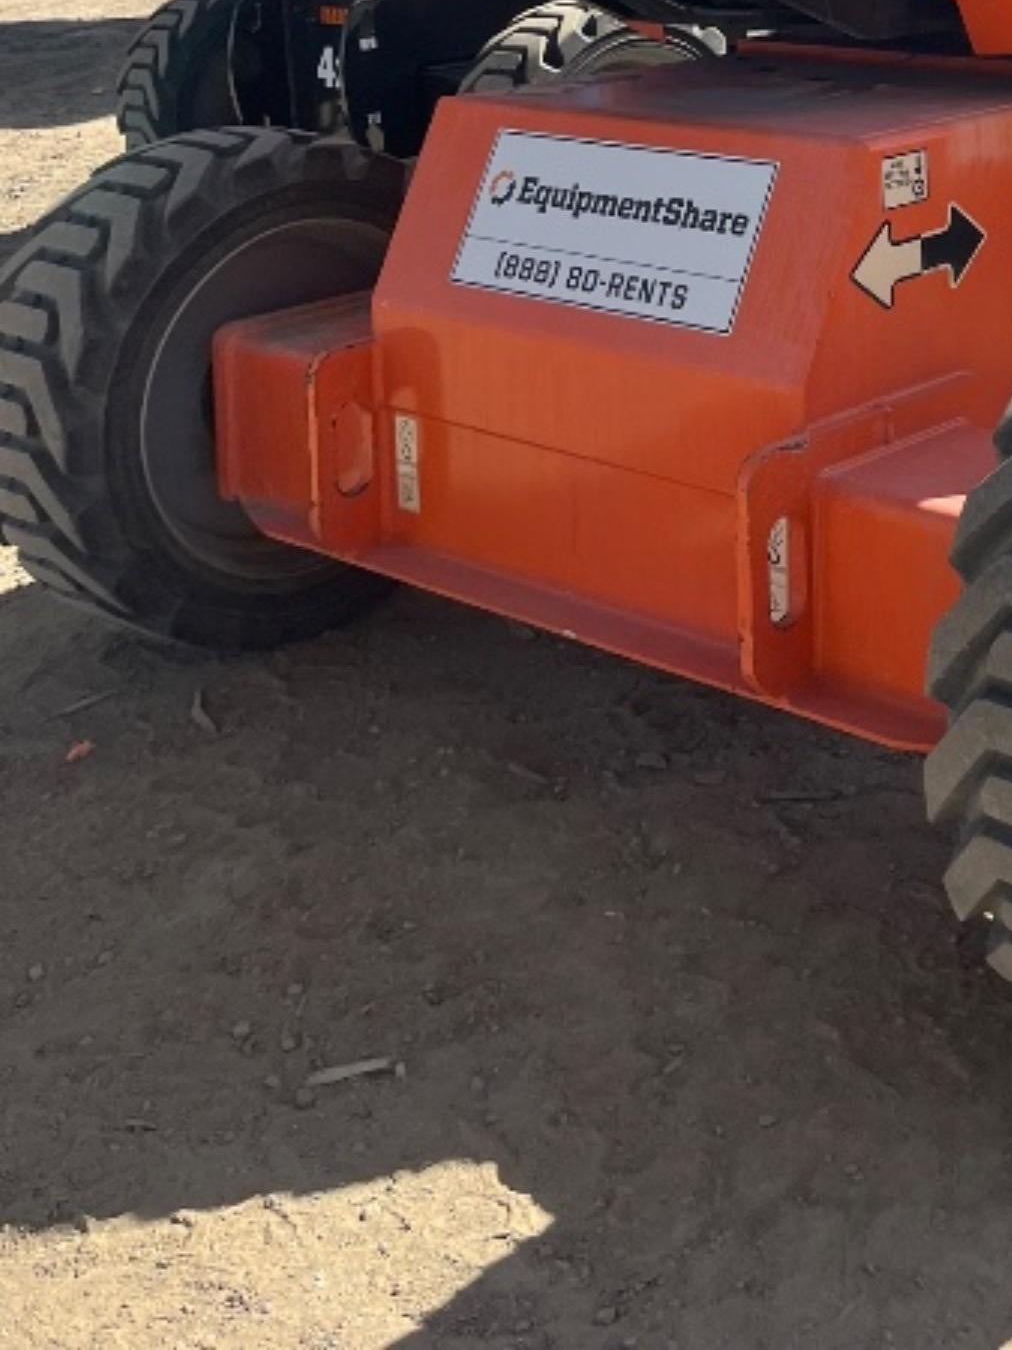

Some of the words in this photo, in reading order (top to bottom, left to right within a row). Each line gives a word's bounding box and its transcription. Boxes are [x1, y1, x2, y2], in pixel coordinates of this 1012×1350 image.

[516, 176, 750, 237] EquipmentShare
[493, 251, 561, 289] (888)
[565, 265, 689, 311] 80-RENTS
